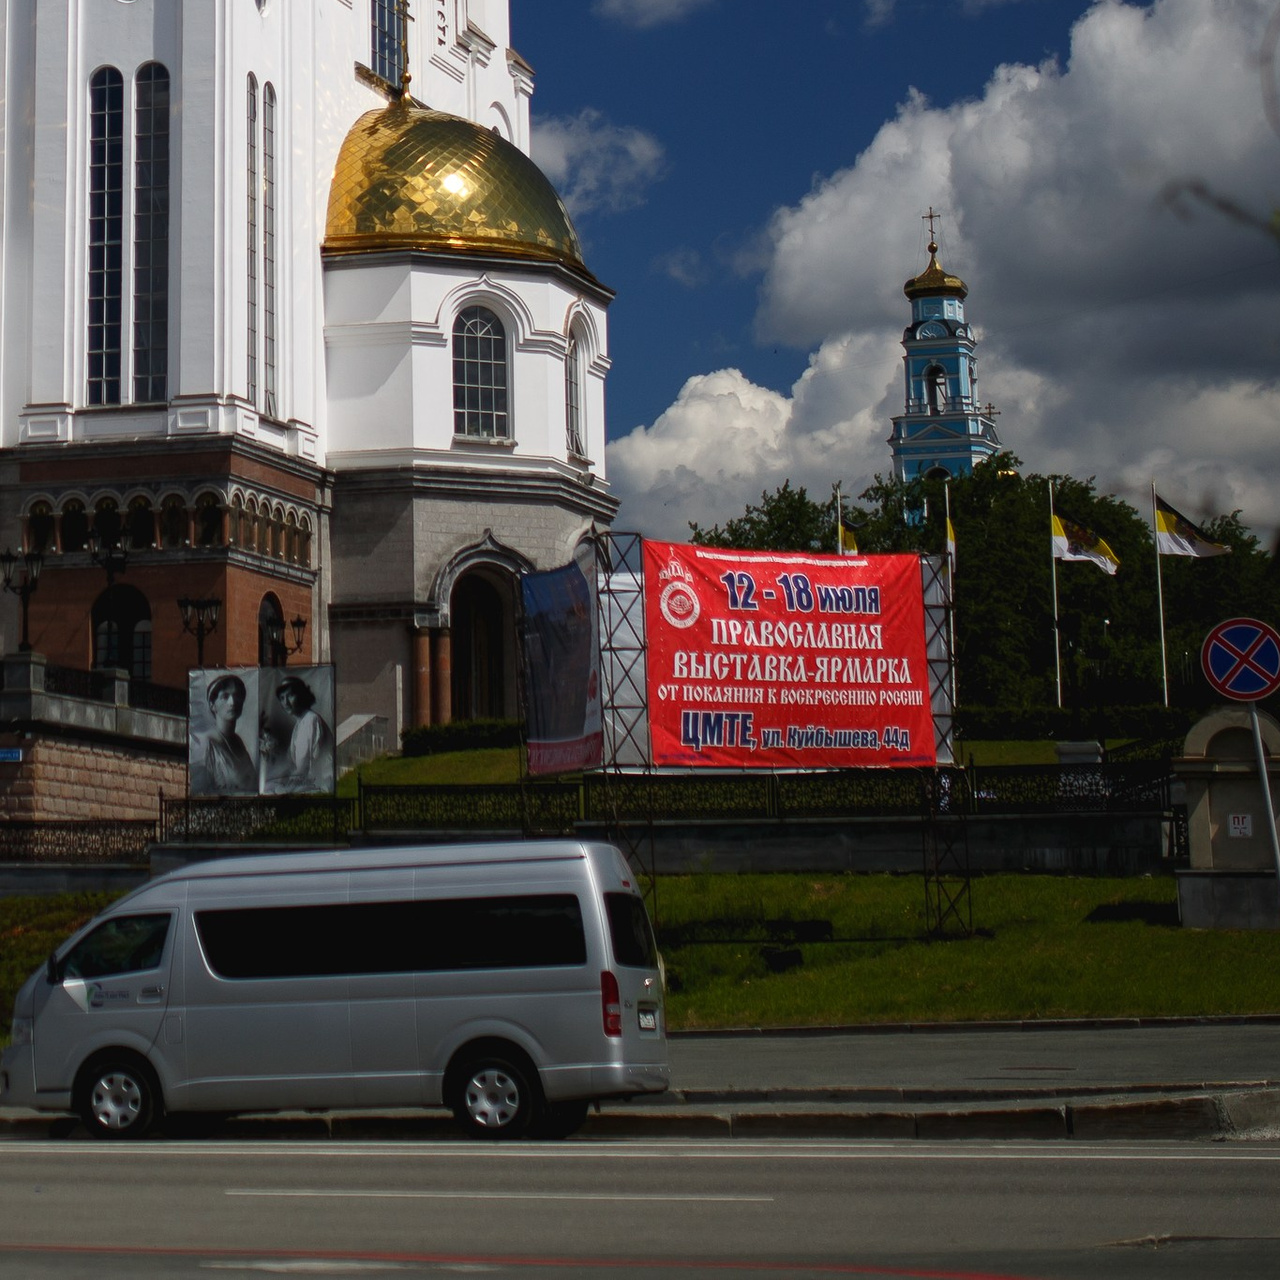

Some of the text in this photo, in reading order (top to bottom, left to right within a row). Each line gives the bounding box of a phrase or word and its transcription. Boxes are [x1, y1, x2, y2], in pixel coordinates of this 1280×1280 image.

[721, 571, 759, 610] 12
[776, 572, 814, 613] 18
[710, 619, 884, 650] ПРАВОСЛАВНАЯ
[672, 650, 912, 684] ВЫСТАВКА-ЯРМАРКА
[657, 684, 923, 706] ОТ ПОКАЯНИЯ К ВОСКРЕСЕНИЮ РОССИИ
[681, 710, 911, 751] ЦМТЕ, ул. Куйбышева, 44д
